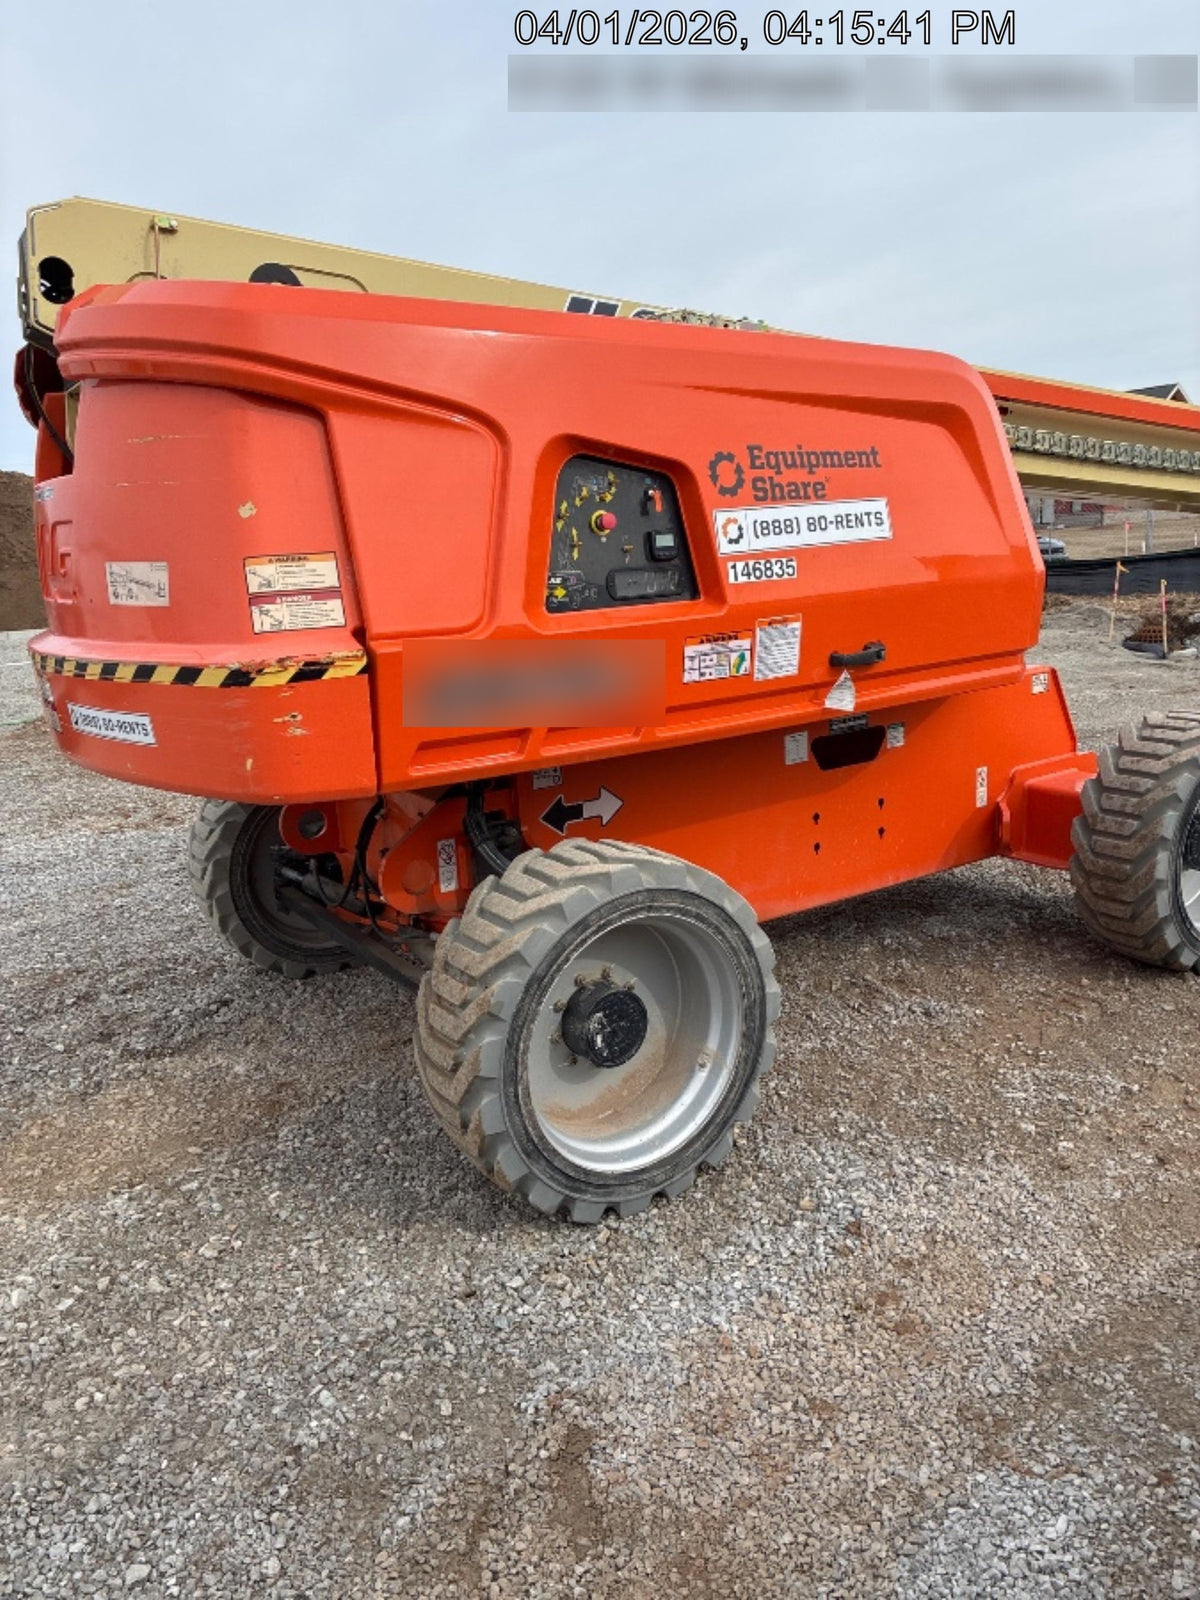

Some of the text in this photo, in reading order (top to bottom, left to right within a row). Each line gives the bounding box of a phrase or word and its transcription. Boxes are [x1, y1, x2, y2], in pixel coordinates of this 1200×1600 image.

[747, 444, 881, 475] Equipment
[752, 476, 826, 502] Share
[753, 511, 884, 539] (888) 80-RENTS
[730, 558, 795, 581] 146835
